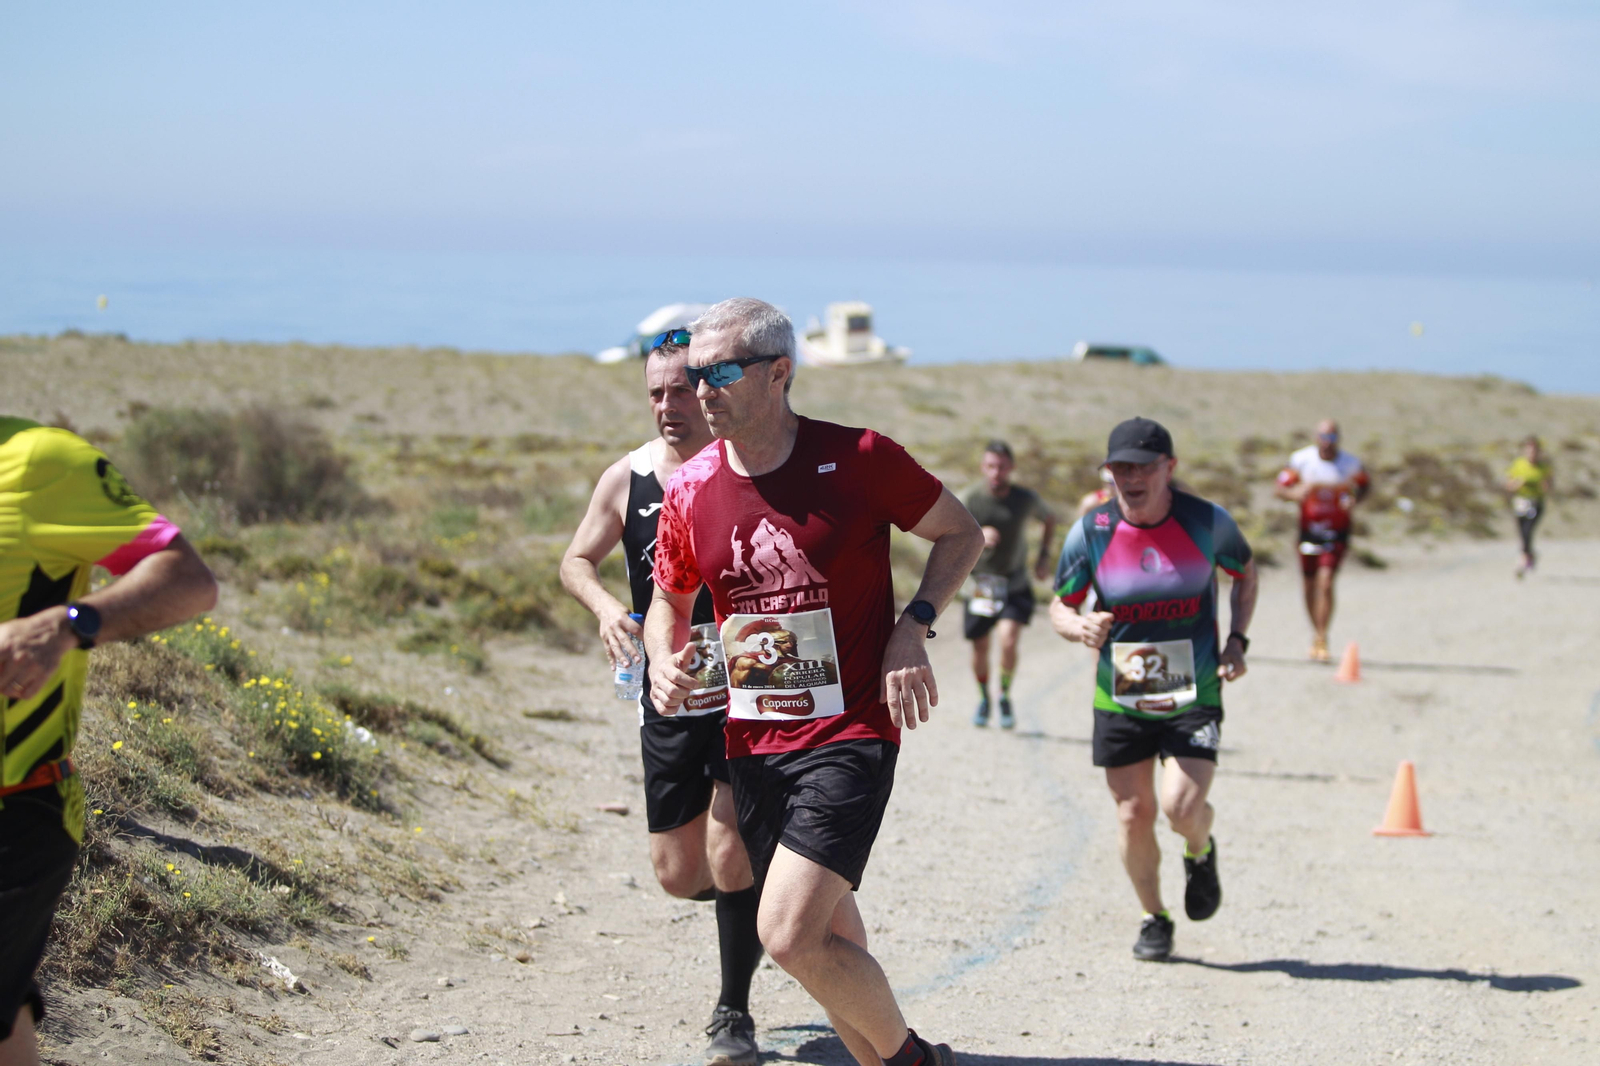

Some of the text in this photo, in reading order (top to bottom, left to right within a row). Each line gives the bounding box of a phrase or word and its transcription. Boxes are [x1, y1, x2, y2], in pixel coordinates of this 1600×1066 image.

[760, 588, 829, 612] CASTILLO
[782, 660, 825, 671] XIII
[1129, 654, 1163, 680] 32
[783, 668, 826, 676] CARRERA
[784, 672, 826, 681] POPULAR
